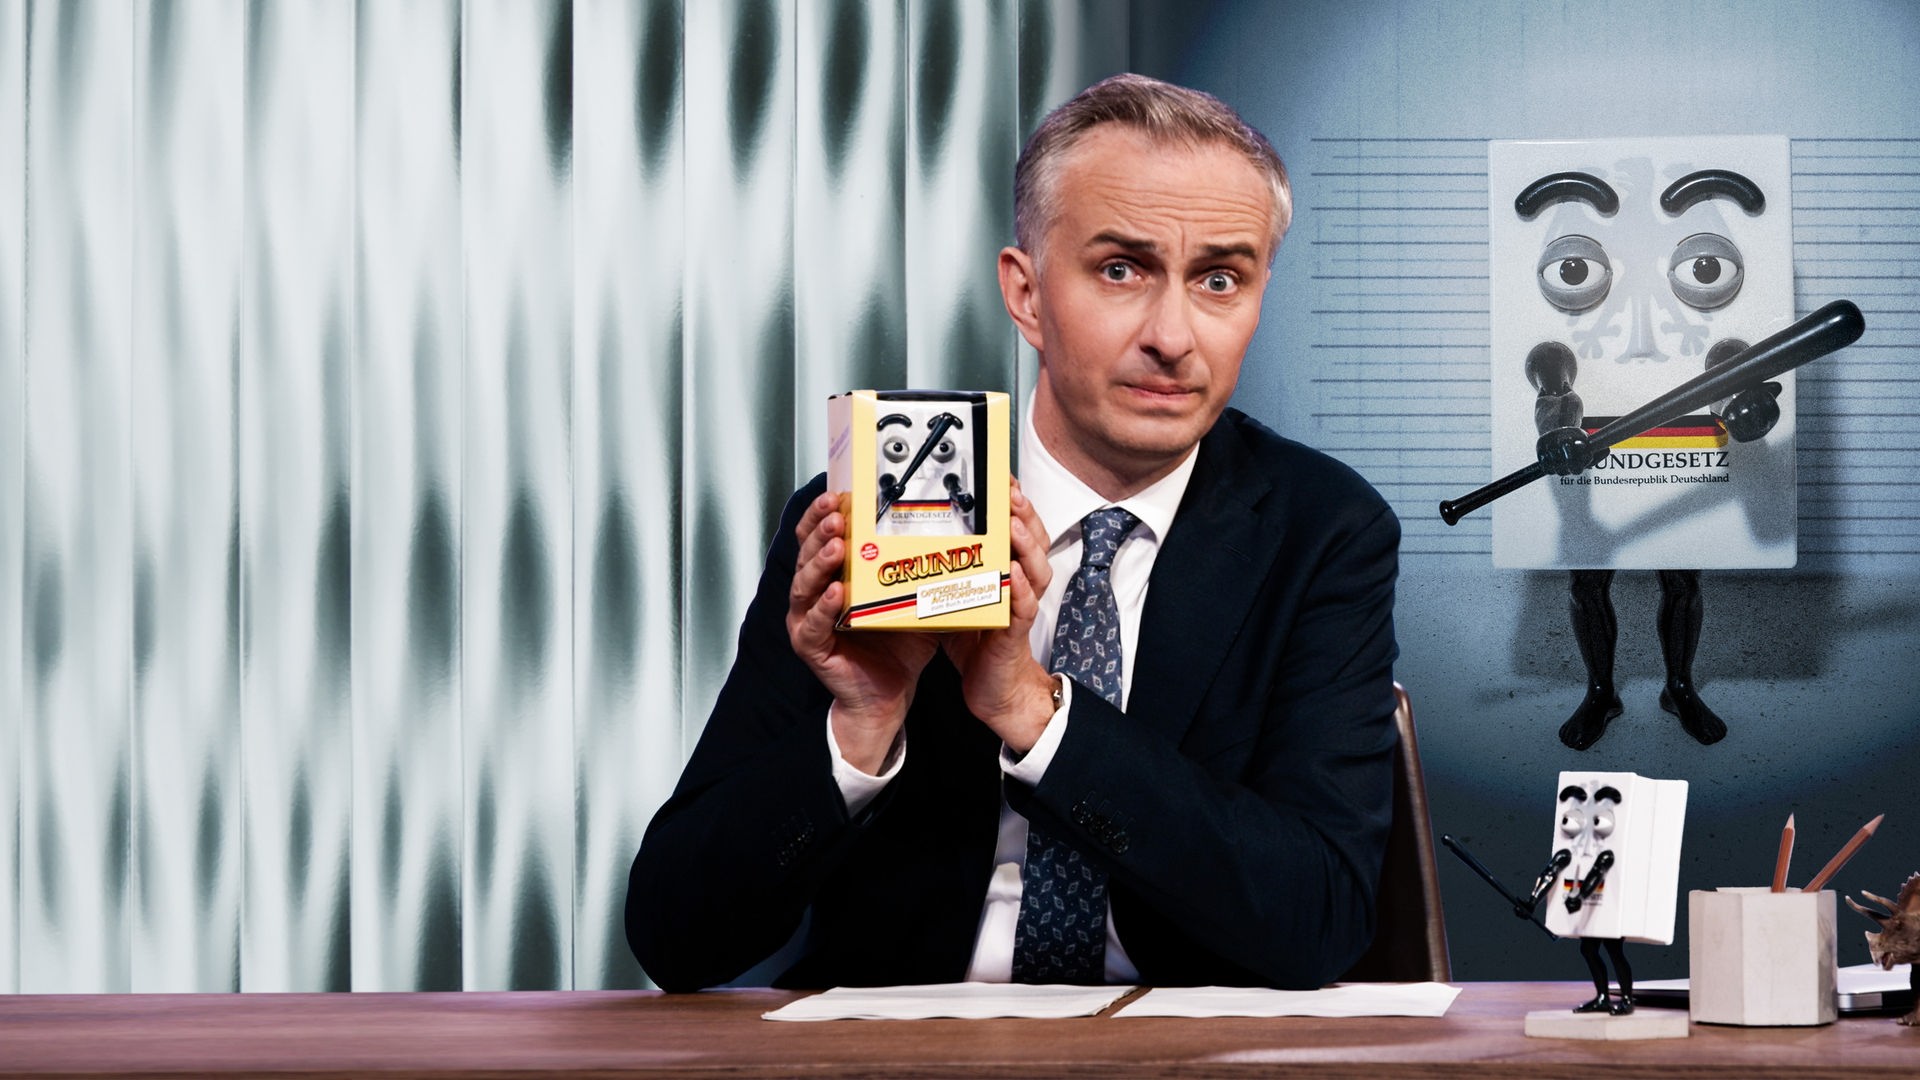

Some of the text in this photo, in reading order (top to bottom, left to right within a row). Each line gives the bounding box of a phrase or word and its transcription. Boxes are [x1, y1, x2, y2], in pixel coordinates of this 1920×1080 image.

[1586, 452, 1730, 470] UNDGESETZ
[1560, 473, 1729, 487] für die Bundesrepublik Deutschland
[891, 511, 952, 519] GRUNDGESETZ
[877, 543, 984, 586] GRUNDI
